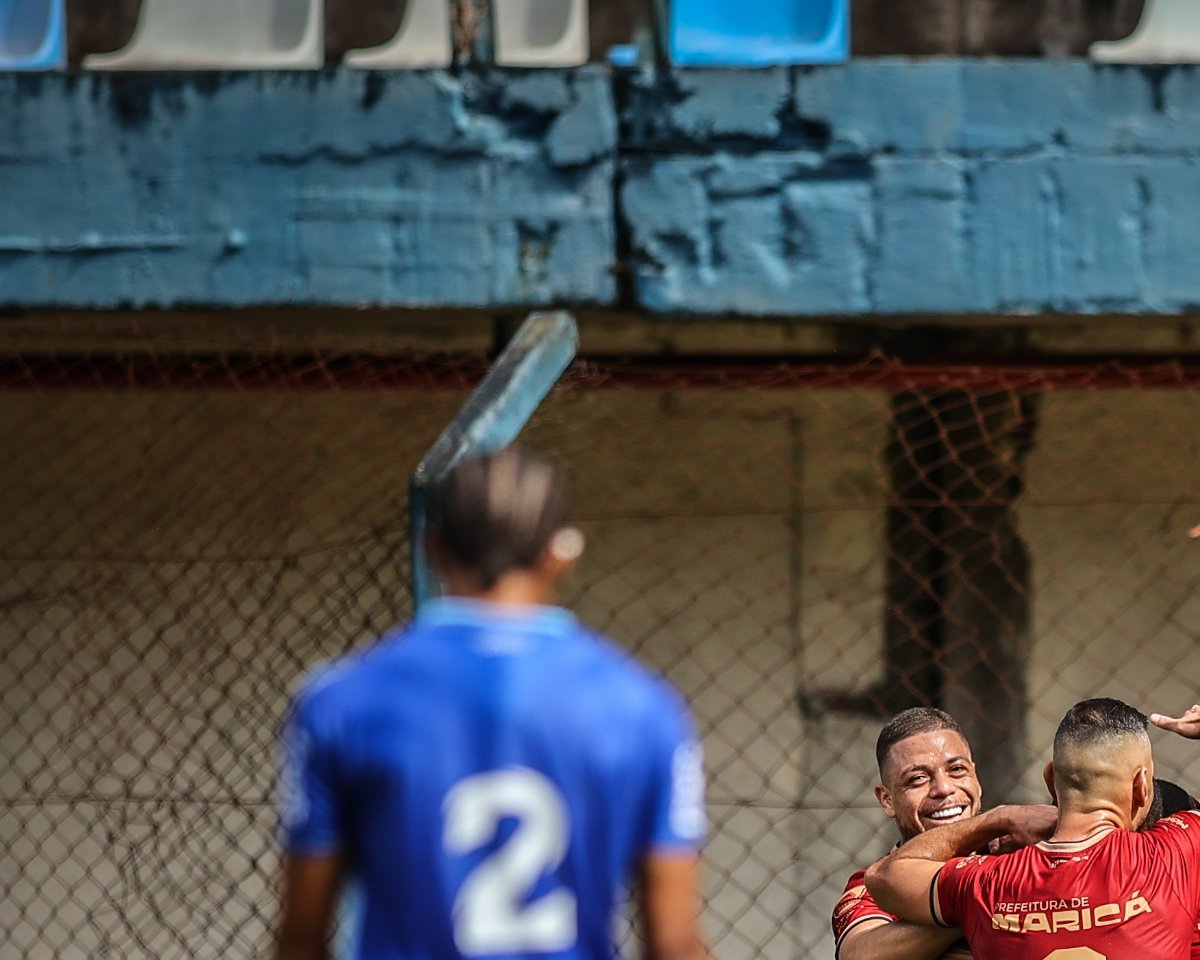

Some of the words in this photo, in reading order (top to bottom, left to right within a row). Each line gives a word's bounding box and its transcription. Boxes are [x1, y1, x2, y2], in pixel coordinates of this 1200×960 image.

[443, 765, 577, 958] 2
[991, 890, 1152, 934] MARICÁ
[994, 899, 1068, 913] PREFEITURA
[1071, 896, 1090, 909] DE
